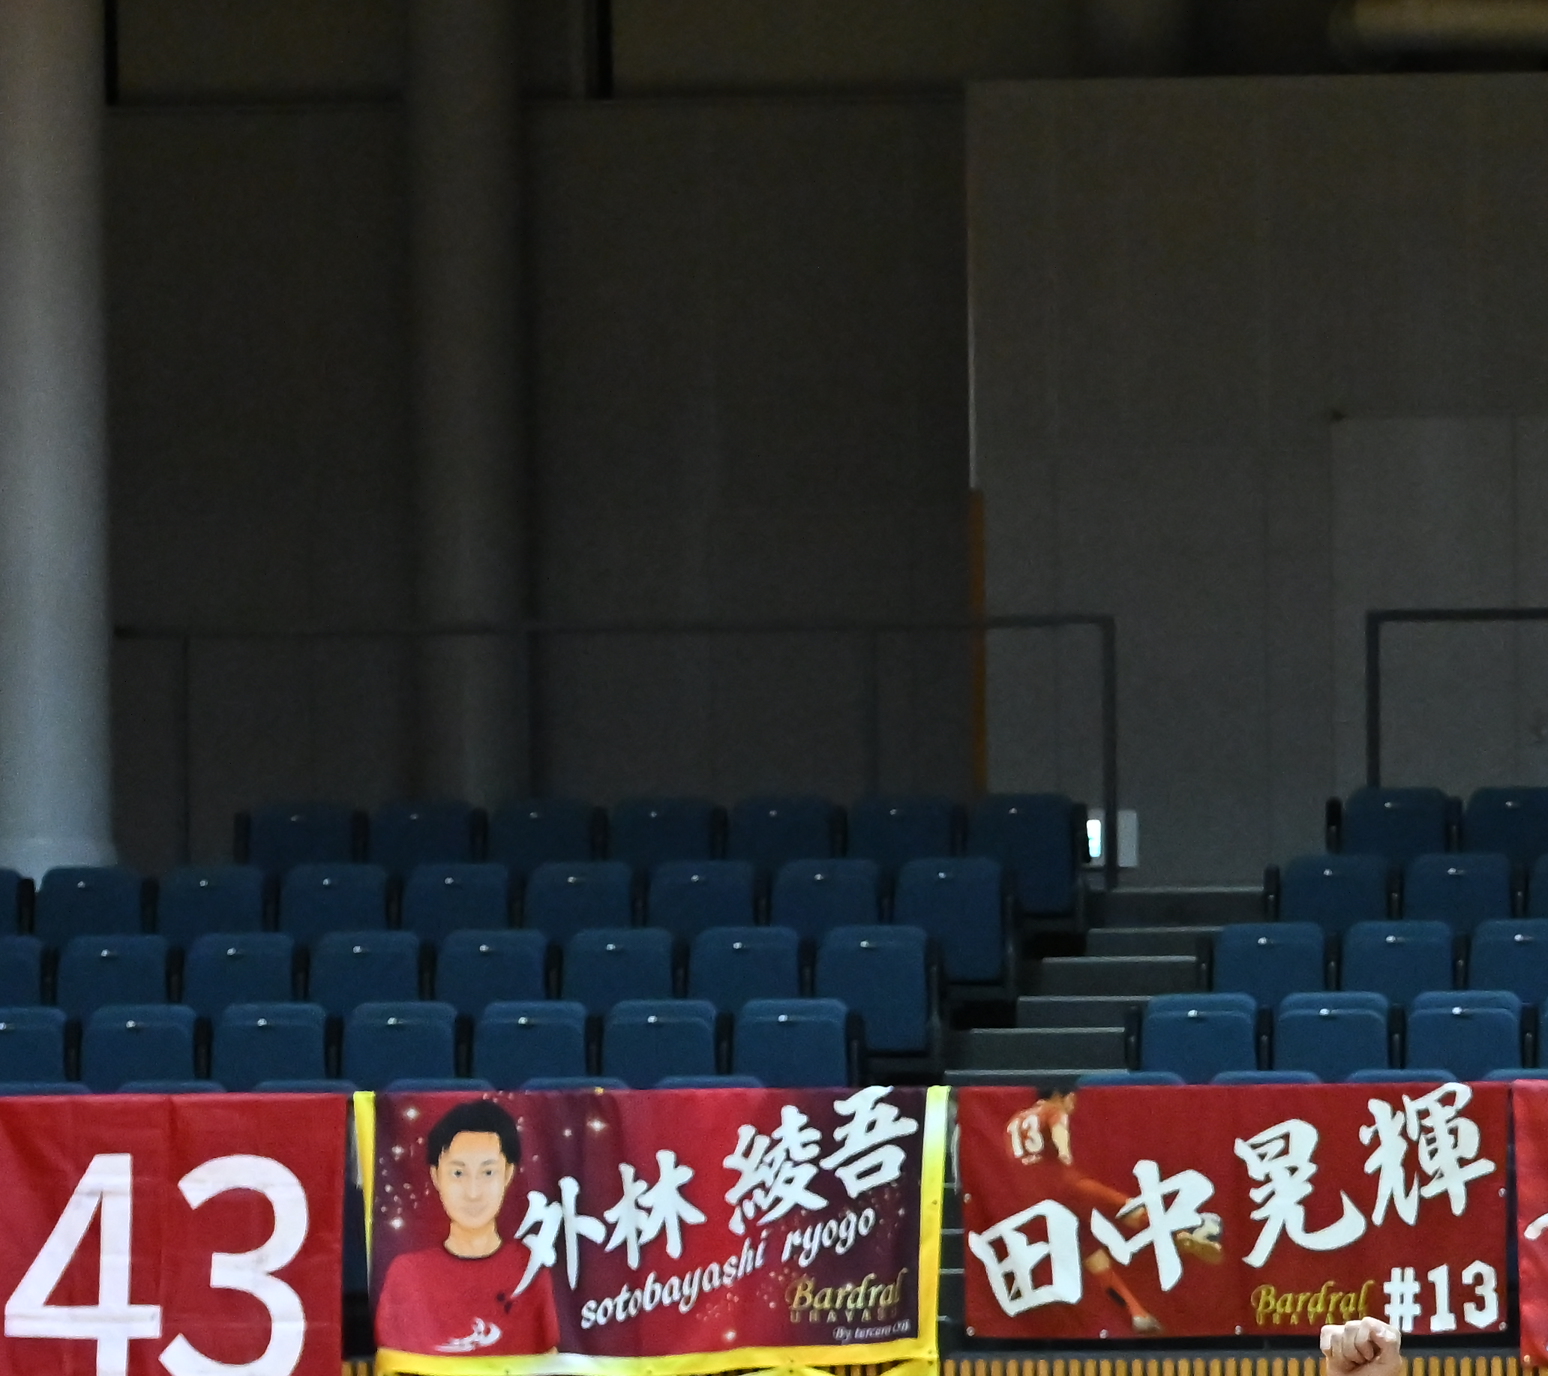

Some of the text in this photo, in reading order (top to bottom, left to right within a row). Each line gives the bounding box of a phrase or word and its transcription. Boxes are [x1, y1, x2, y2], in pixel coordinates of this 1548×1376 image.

[581, 1208, 876, 1330] sotobayashi ryogo
[785, 1267, 908, 1311] Bardral
[1251, 1279, 1375, 1315] Bardral
[1383, 1260, 1499, 1333] #13
